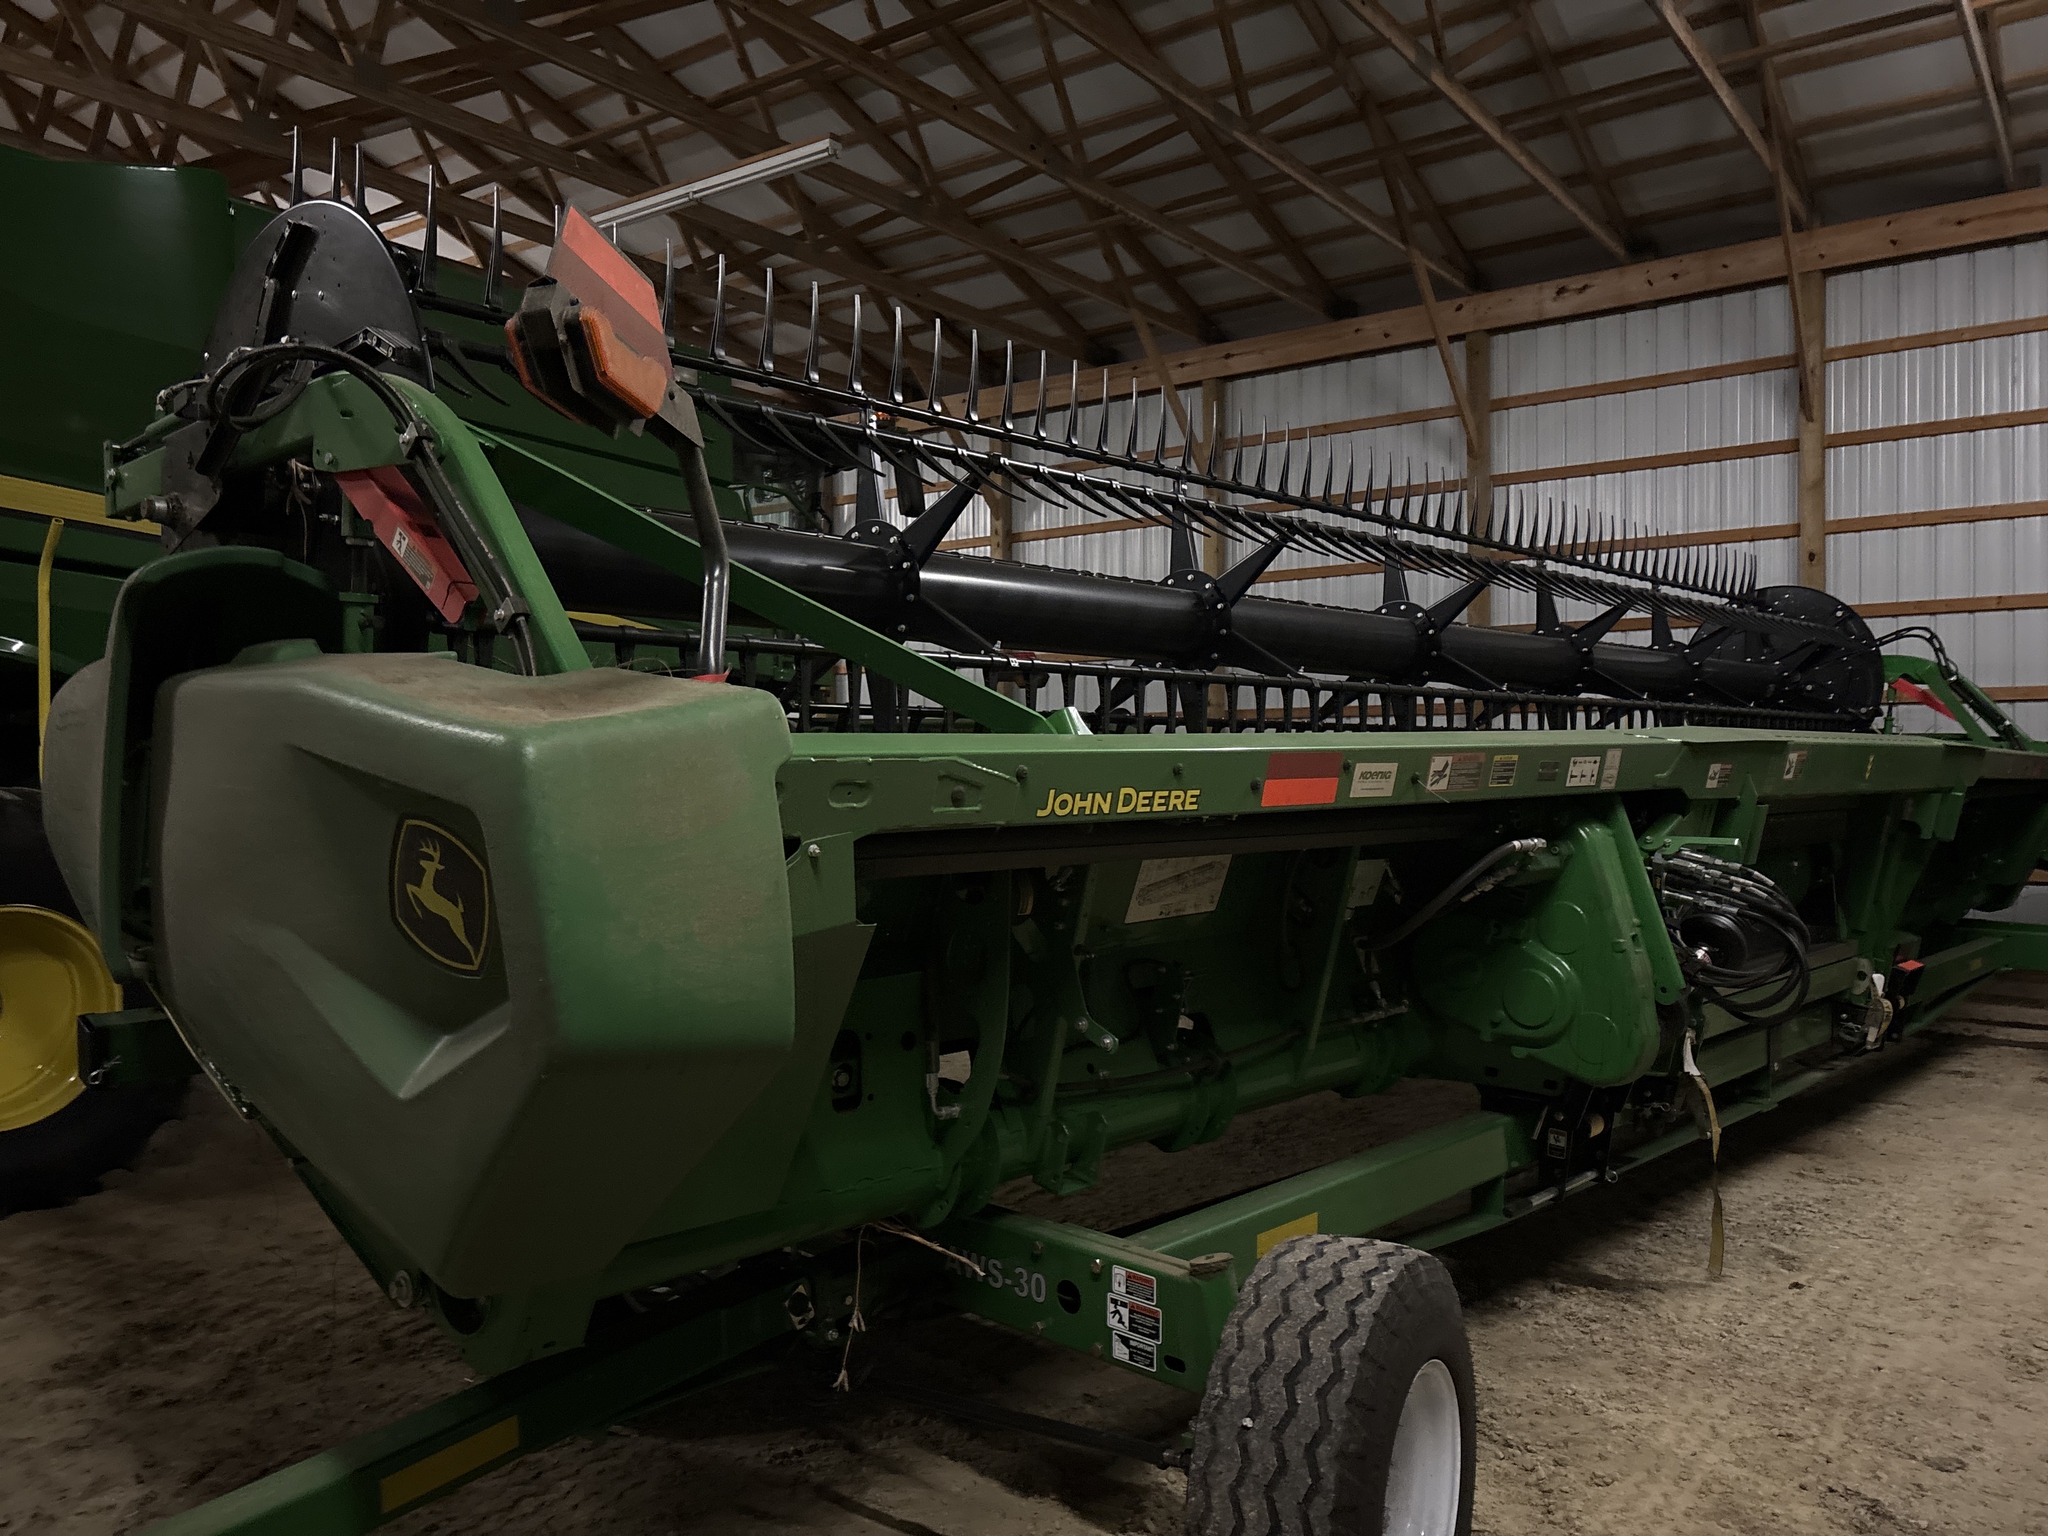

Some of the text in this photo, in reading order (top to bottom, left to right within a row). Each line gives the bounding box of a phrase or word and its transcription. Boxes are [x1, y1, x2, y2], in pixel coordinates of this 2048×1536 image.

[1036, 786, 1201, 818] JOHN DEERE
[945, 1245, 1046, 1303] AWS-30
